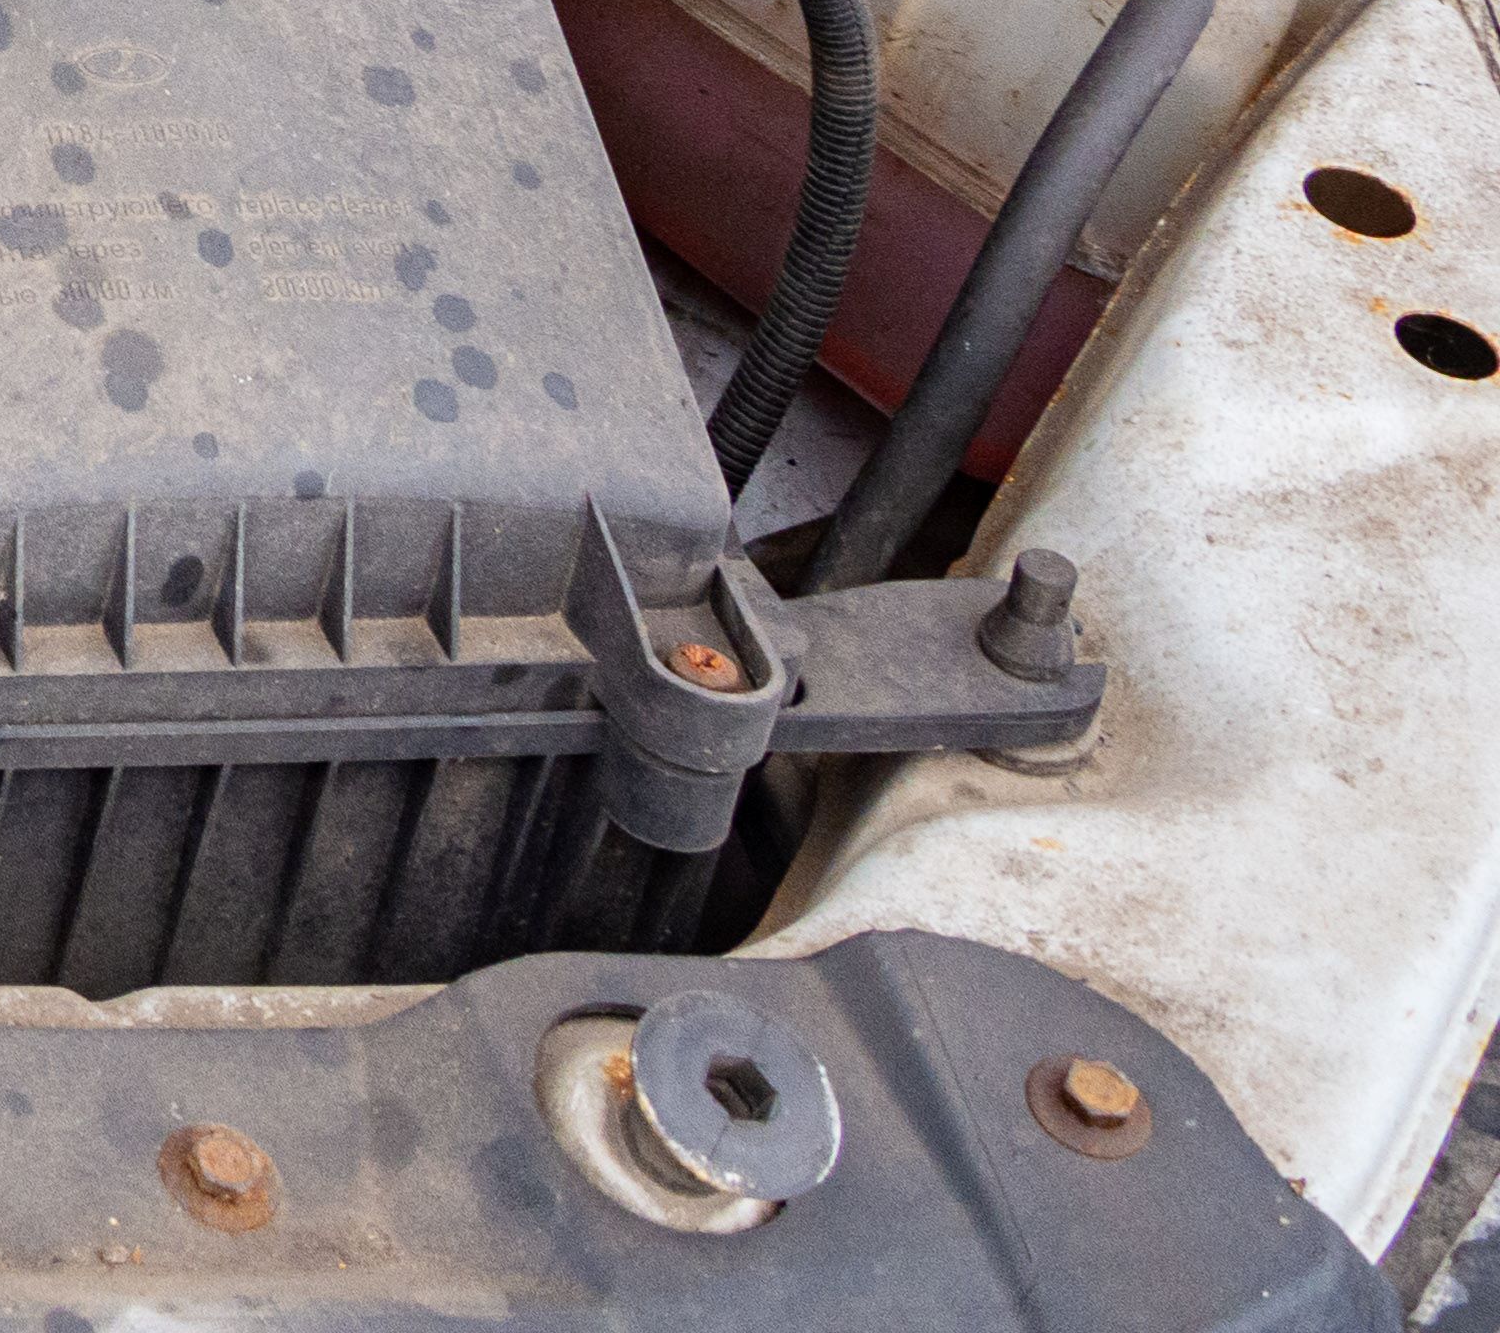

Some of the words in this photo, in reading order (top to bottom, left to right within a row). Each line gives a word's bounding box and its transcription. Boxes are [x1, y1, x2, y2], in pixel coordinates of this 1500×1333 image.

[236, 192, 323, 220] replace
[327, 193, 412, 217] cleaner
[248, 232, 345, 259] element
